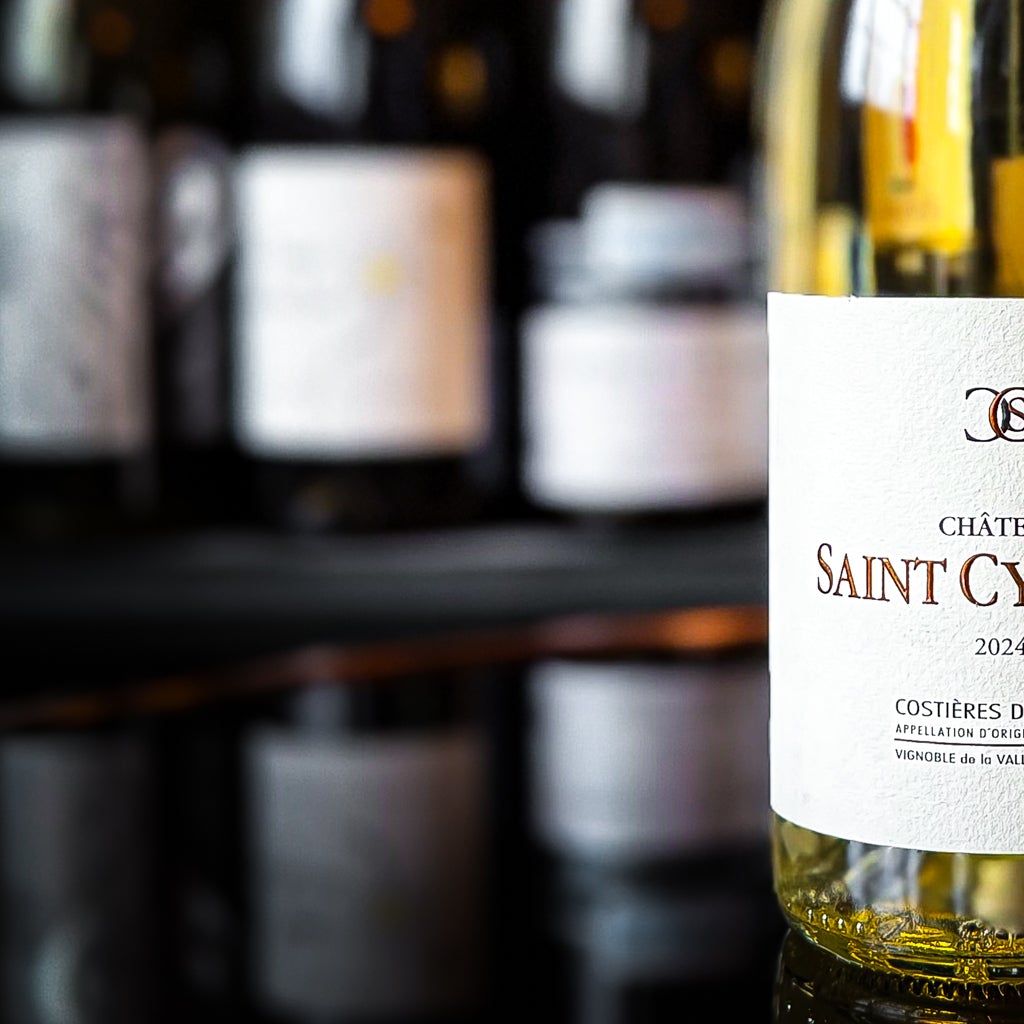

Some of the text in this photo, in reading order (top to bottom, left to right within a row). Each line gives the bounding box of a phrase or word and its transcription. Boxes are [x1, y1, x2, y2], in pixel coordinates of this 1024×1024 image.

[817, 543, 947, 606] SAINT
[895, 698, 1002, 720] COSTIÈRES
[895, 723, 974, 738] APPELLATION
[895, 748, 956, 764] VIGNOBLE
[960, 753, 976, 765] de
[981, 753, 992, 765] la
